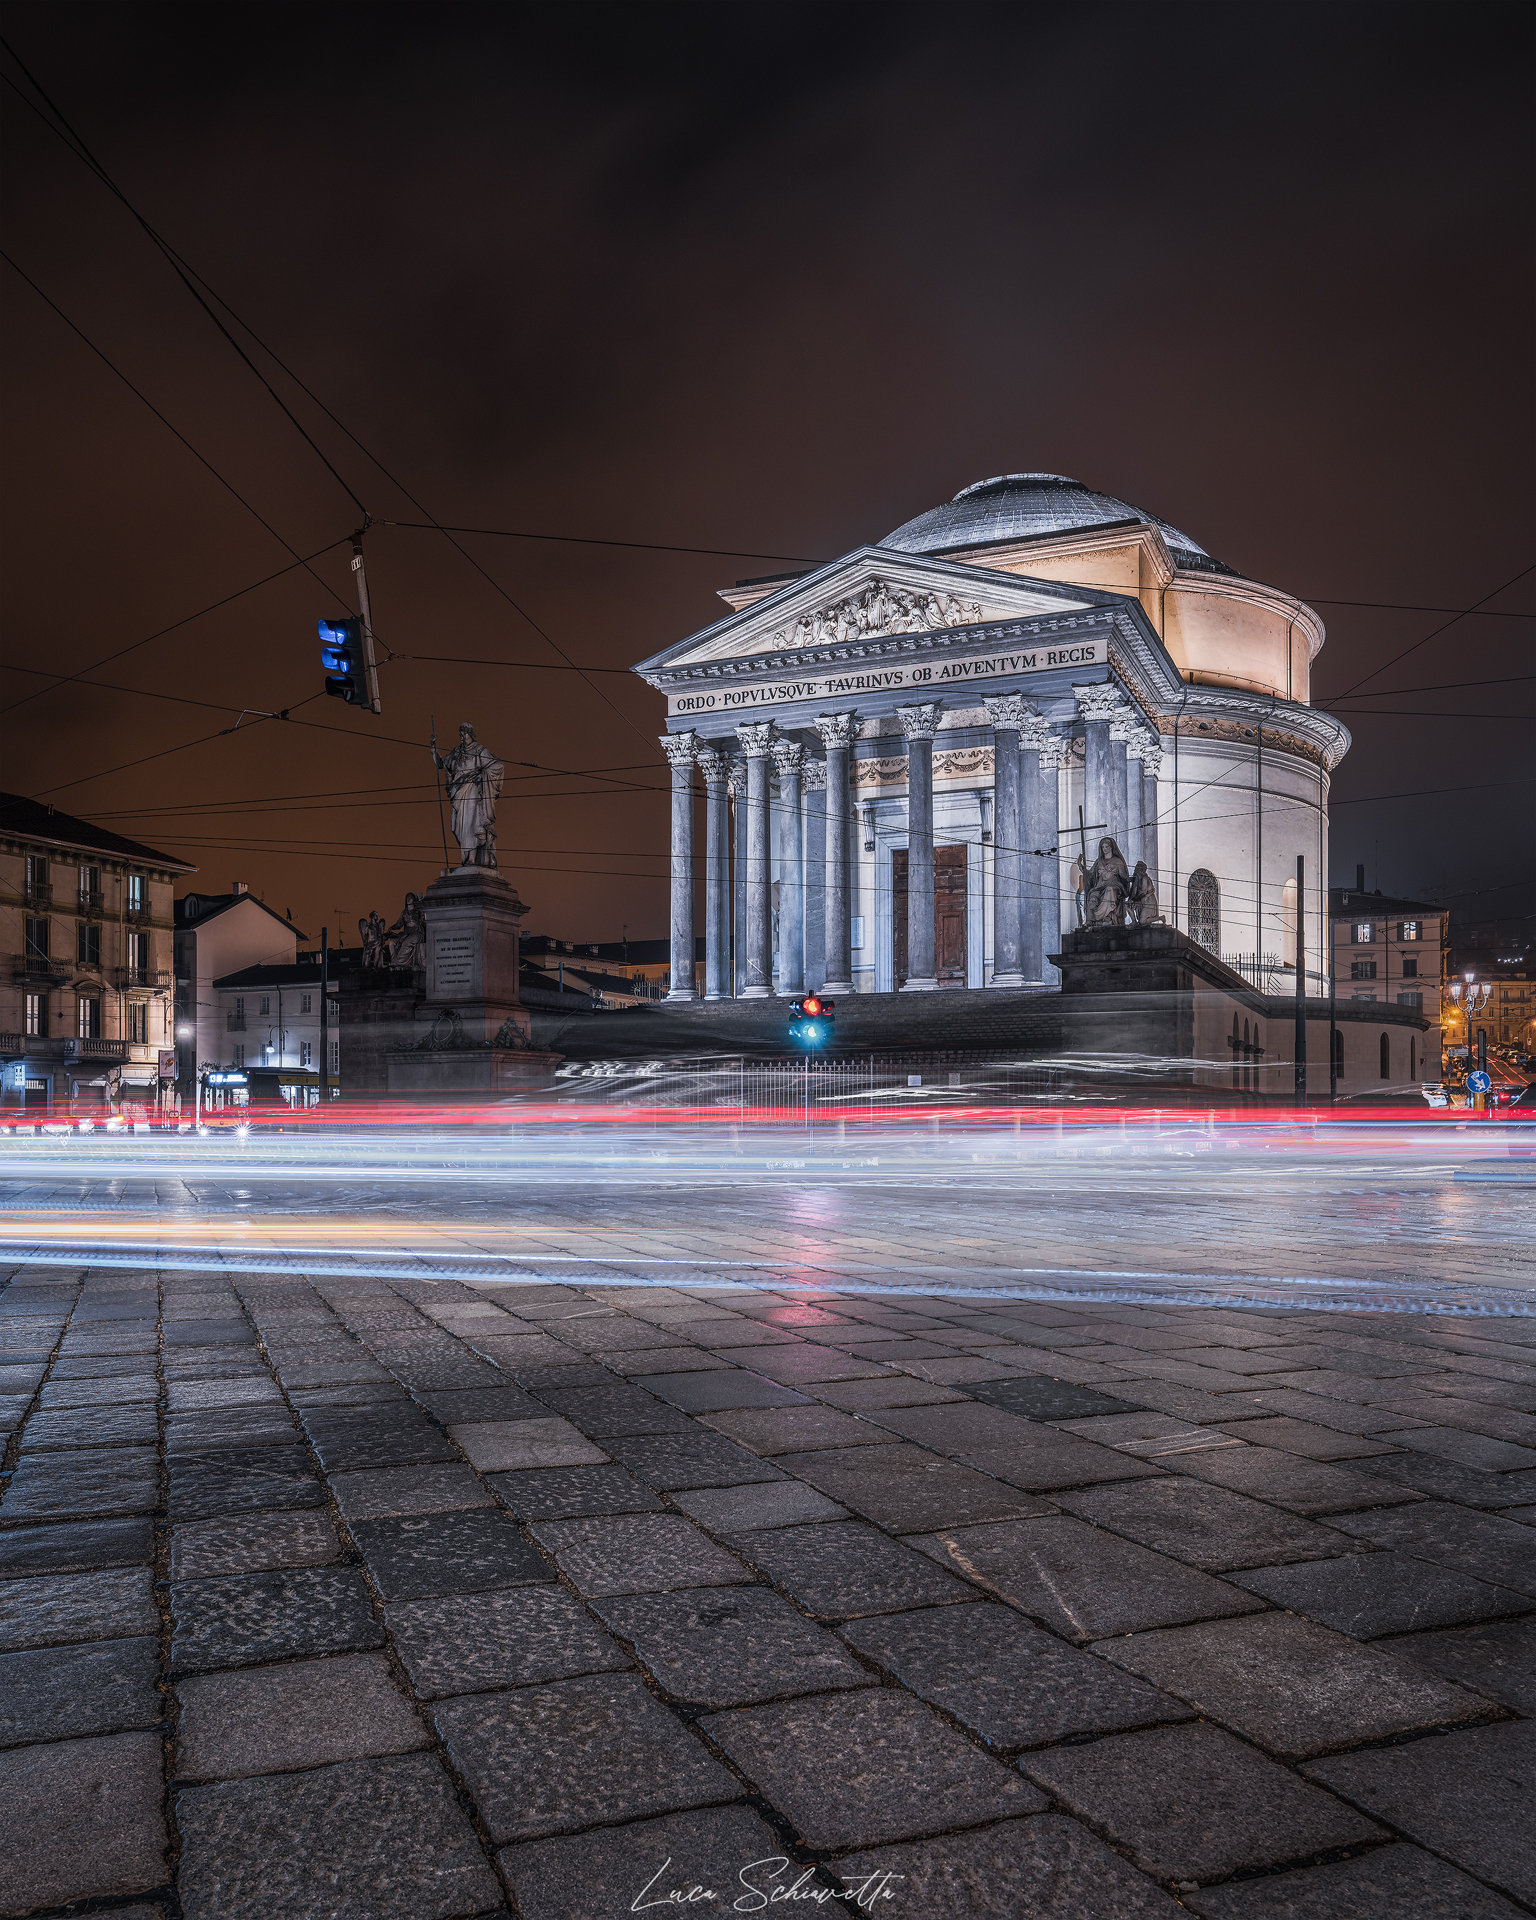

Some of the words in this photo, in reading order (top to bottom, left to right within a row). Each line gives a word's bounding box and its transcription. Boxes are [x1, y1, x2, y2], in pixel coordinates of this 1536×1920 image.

[676, 695, 716, 711] ORDO
[723, 682, 817, 706] POPVLVSQVE
[824, 671, 903, 693] TAVRINVS
[911, 667, 932, 682] OB
[938, 653, 1037, 679] ADVENTVM
[1046, 646, 1096, 666] REGIS
